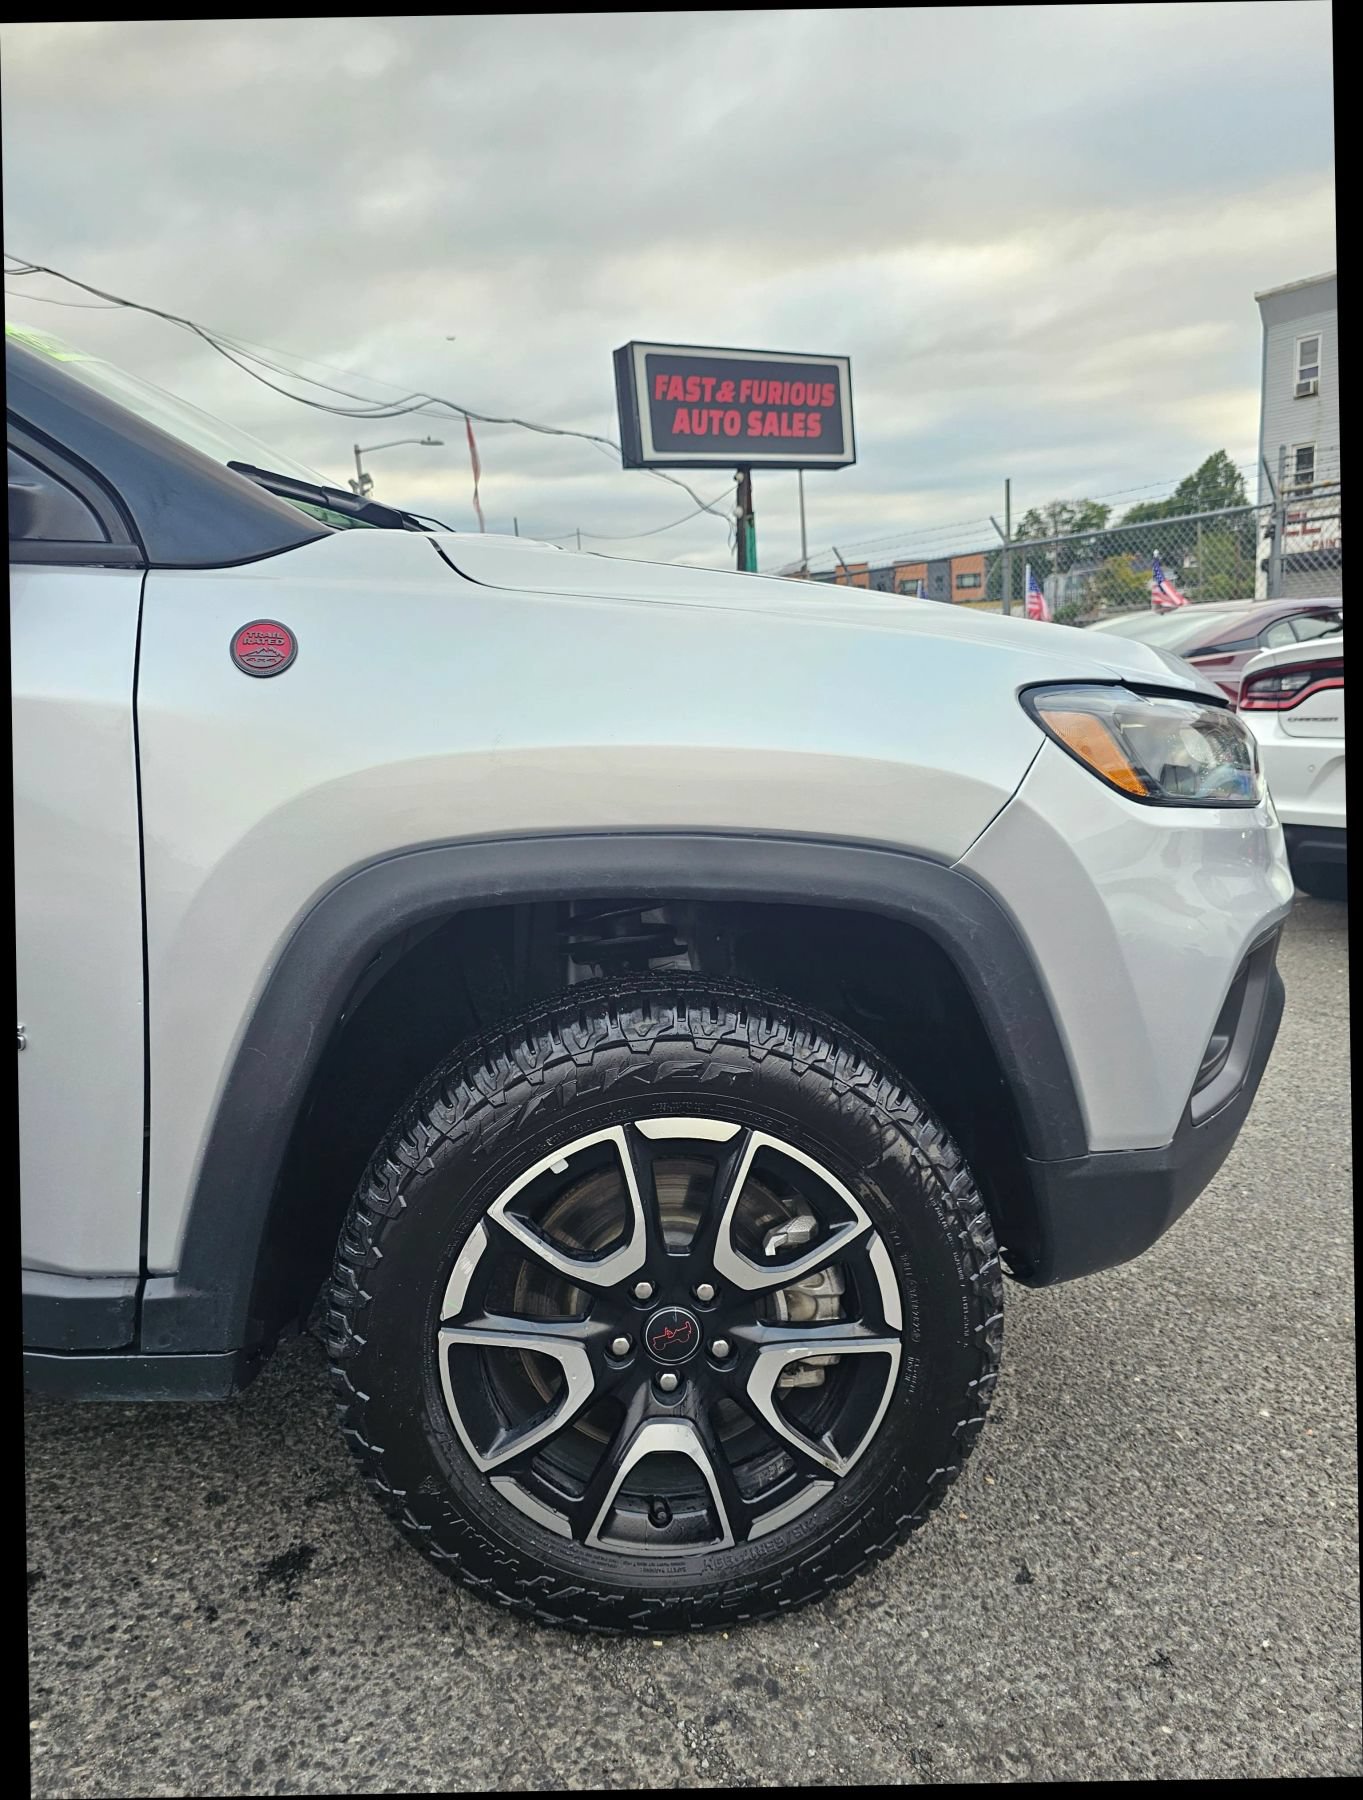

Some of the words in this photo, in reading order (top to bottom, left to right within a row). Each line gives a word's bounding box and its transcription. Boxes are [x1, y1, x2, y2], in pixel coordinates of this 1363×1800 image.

[654, 374, 717, 404] FAST
[715, 380, 736, 404] &
[739, 379, 836, 408] FURIOUS
[672, 408, 741, 437] AUTO
[746, 411, 822, 438] SALES
[243, 638, 285, 646] RATED
[247, 631, 284, 640] TRAIL
